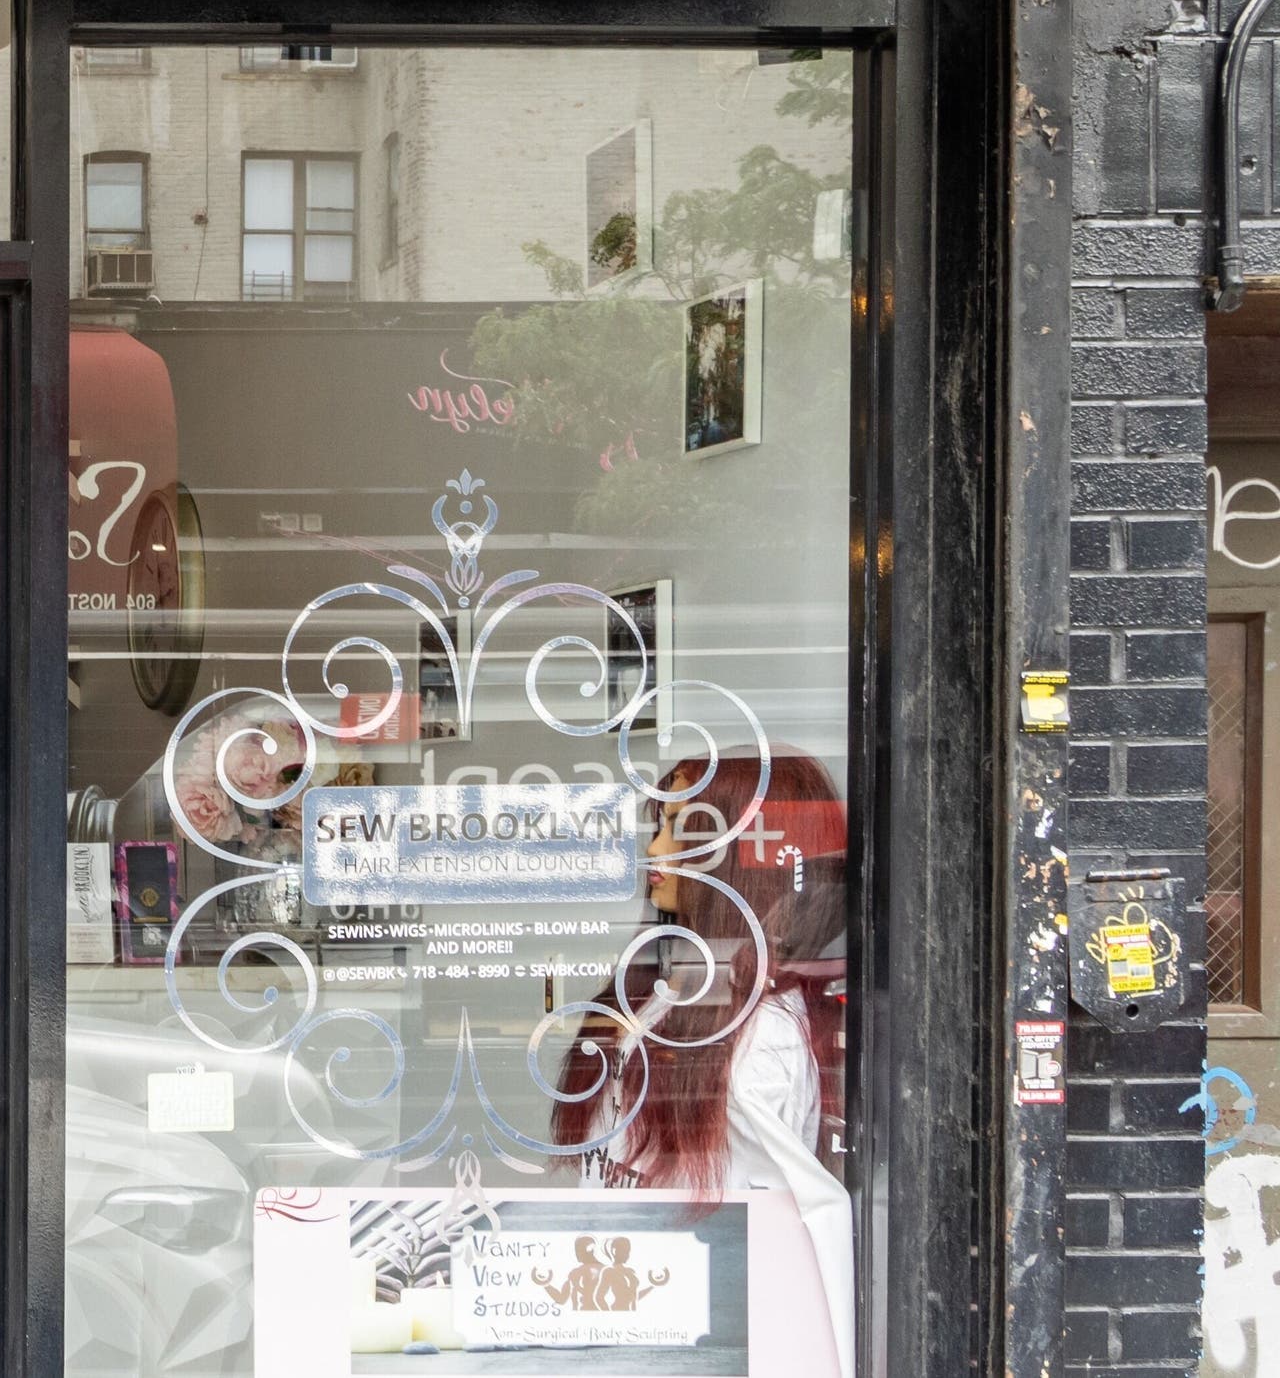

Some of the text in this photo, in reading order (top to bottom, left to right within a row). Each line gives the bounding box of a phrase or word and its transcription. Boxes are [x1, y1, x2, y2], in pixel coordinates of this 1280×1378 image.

[317, 813, 395, 843] SEW
[410, 811, 622, 842] BROOKLYN
[344, 854, 598, 874] HAIR EXTENSION LOUNGE
[534, 922, 578, 935] BLOW
[581, 921, 610, 935] BAR
[427, 940, 513, 955] AND MORE!!
[530, 963, 611, 978] SEWBK.COM
